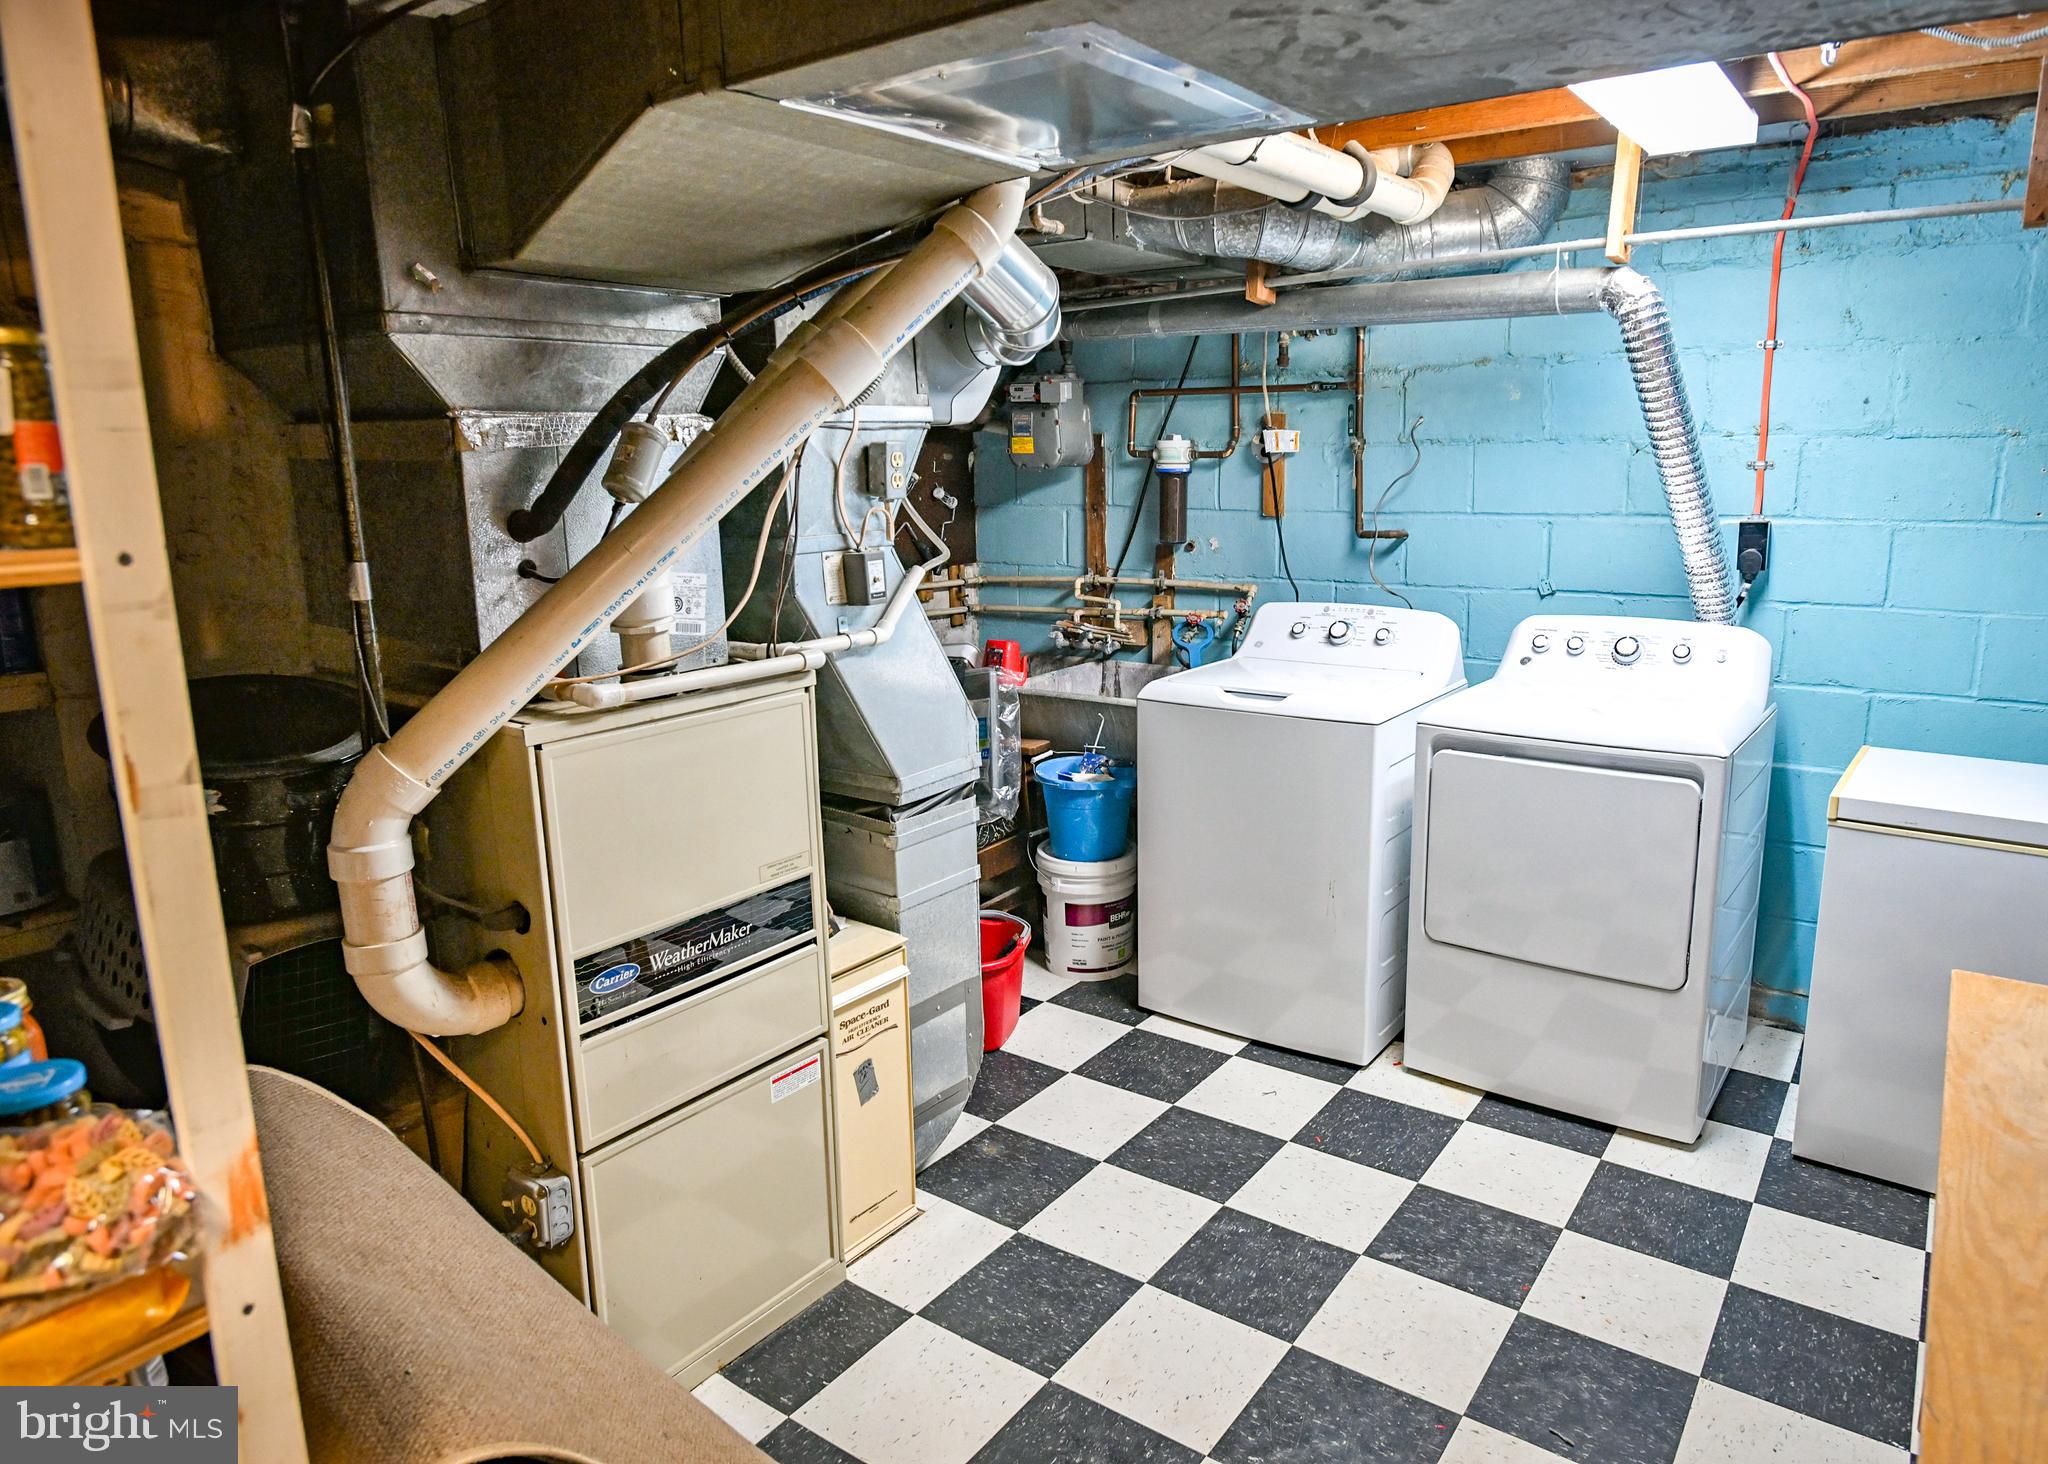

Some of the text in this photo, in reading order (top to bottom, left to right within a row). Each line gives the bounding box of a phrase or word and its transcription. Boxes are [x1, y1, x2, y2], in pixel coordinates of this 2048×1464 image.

[650, 923, 752, 971] WeatherMaker
[676, 949, 730, 973] High Efficiency
[595, 969, 635, 989] Carrier
[839, 1000, 889, 1030] Space-Gard
[842, 1035, 854, 1045] AIR
[857, 1017, 888, 1035] CLEANER
